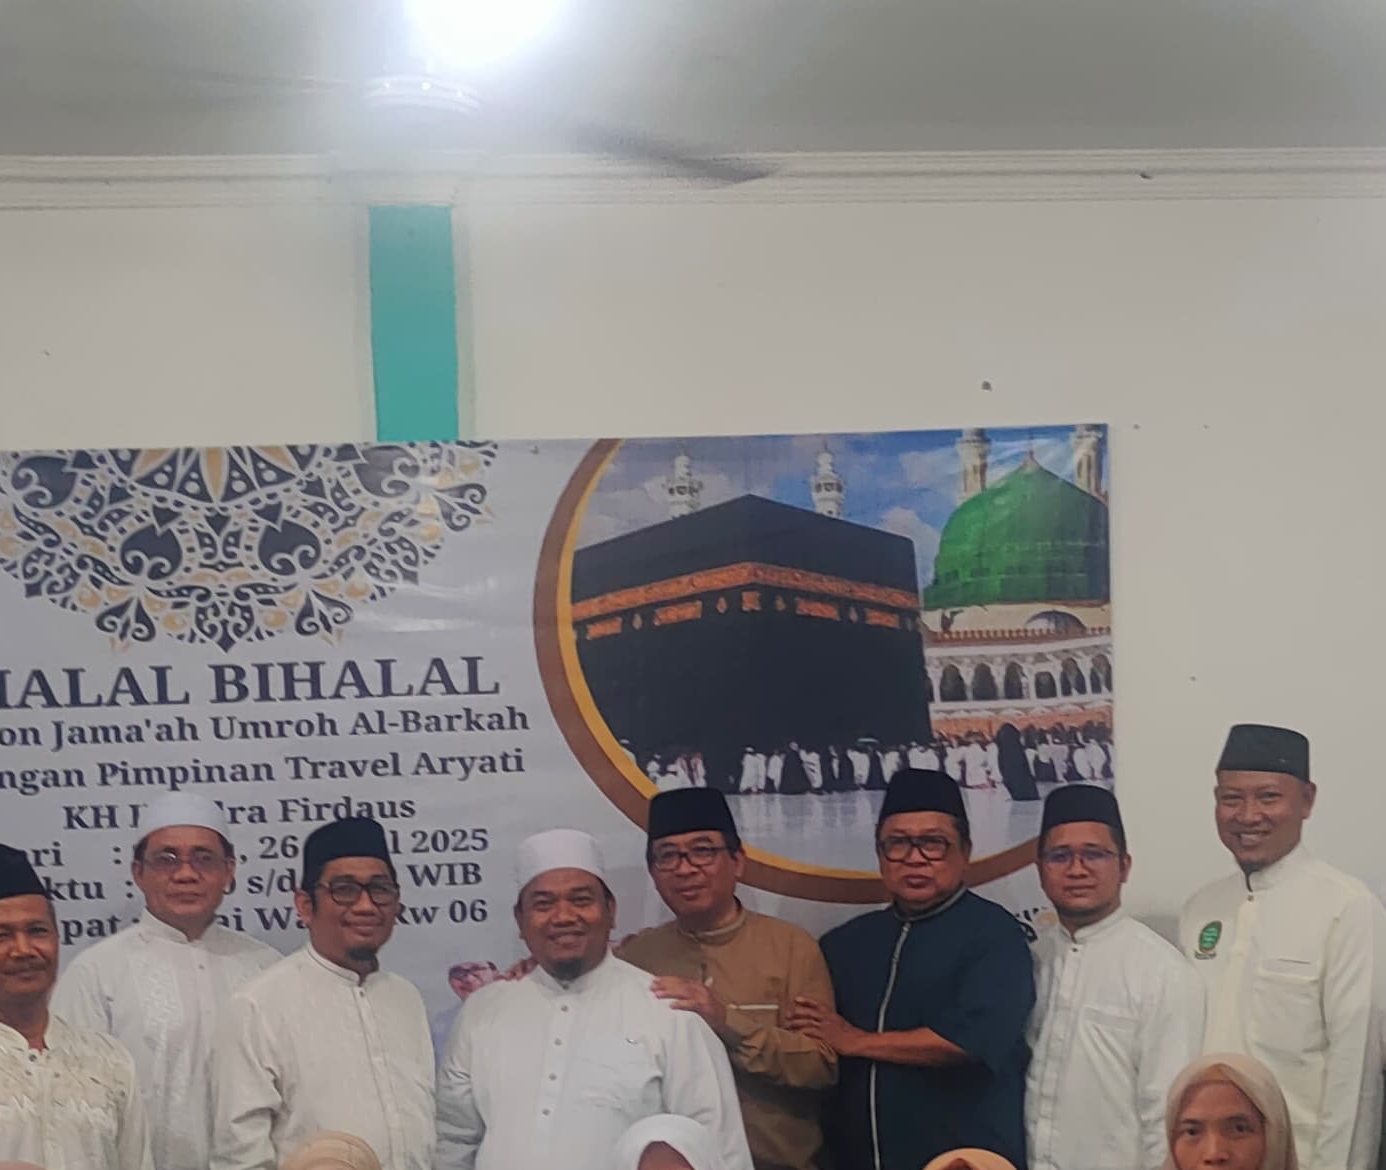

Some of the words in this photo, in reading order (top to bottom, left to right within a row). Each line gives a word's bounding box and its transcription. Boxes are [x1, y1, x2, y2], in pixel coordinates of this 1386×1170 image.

[208, 655, 500, 704] BIHALAL
[50, 716, 199, 752] Jama'ah
[210, 712, 340, 741] Umroh
[349, 706, 530, 735] Al-Barkah
[97, 758, 276, 792] Pimpinan
[285, 752, 402, 781] Travel
[411, 748, 526, 782] Aryati
[62, 803, 120, 831] KH
[278, 796, 417, 824] Firdaus
[259, 835, 300, 859] 26
[411, 828, 489, 854] 2025
[247, 867, 297, 898] s/d
[406, 861, 483, 888] WIB
[449, 898, 489, 924] 06
